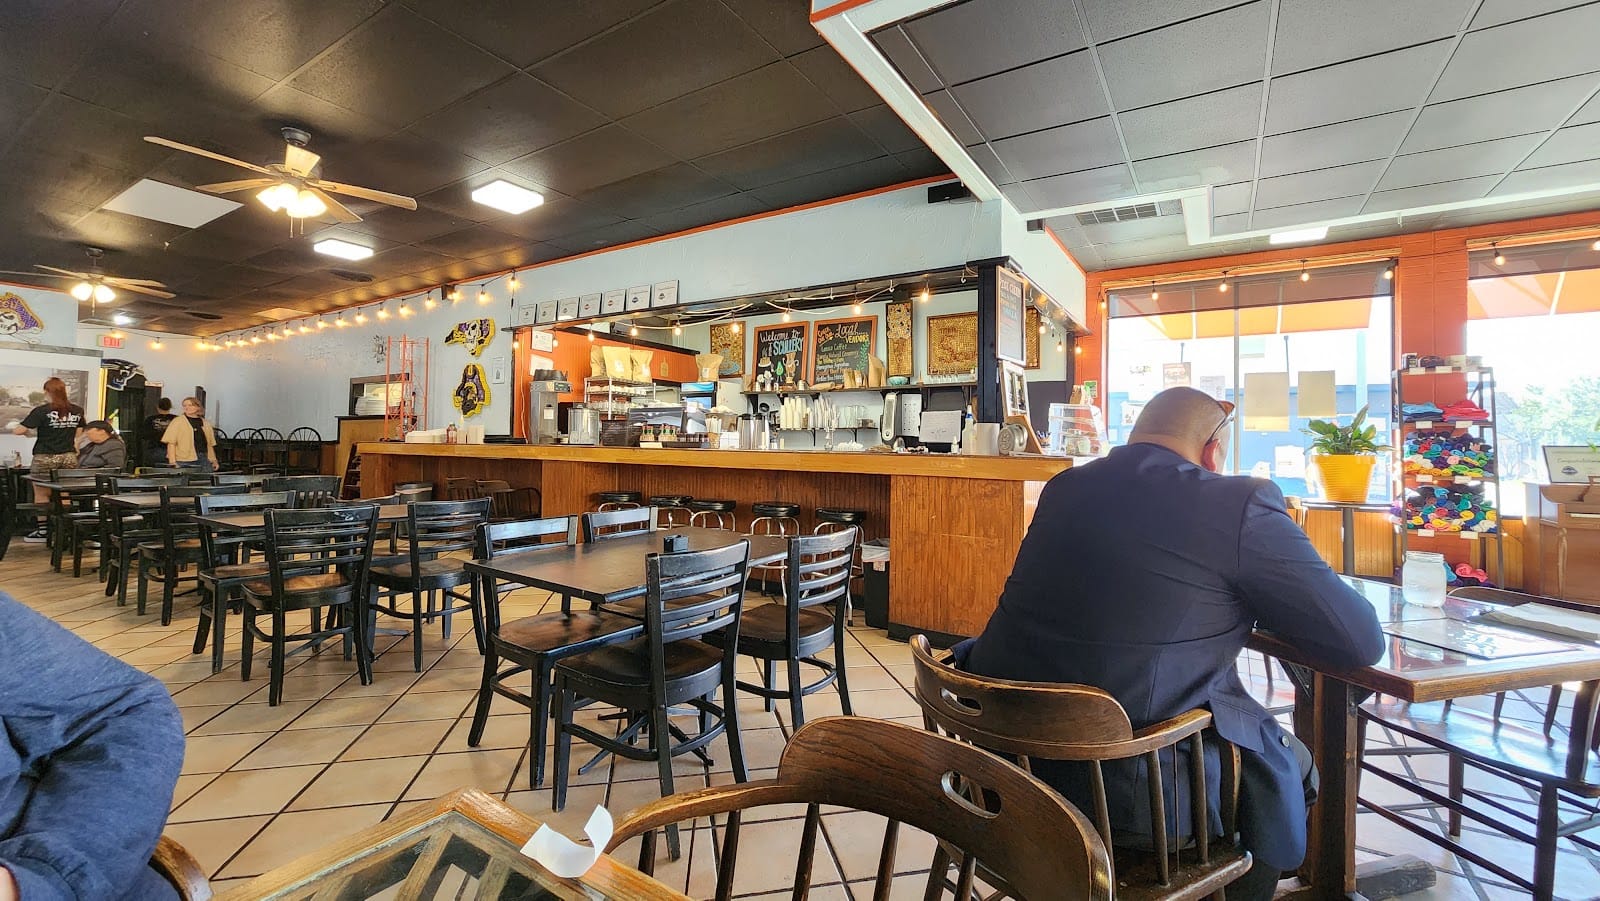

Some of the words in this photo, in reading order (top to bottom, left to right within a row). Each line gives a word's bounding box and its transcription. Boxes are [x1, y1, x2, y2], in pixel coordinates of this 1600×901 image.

[759, 330, 790, 343] Welcome
[791, 328, 801, 338] to
[835, 322, 859, 338] Local
[773, 336, 804, 356] SCULLERY
